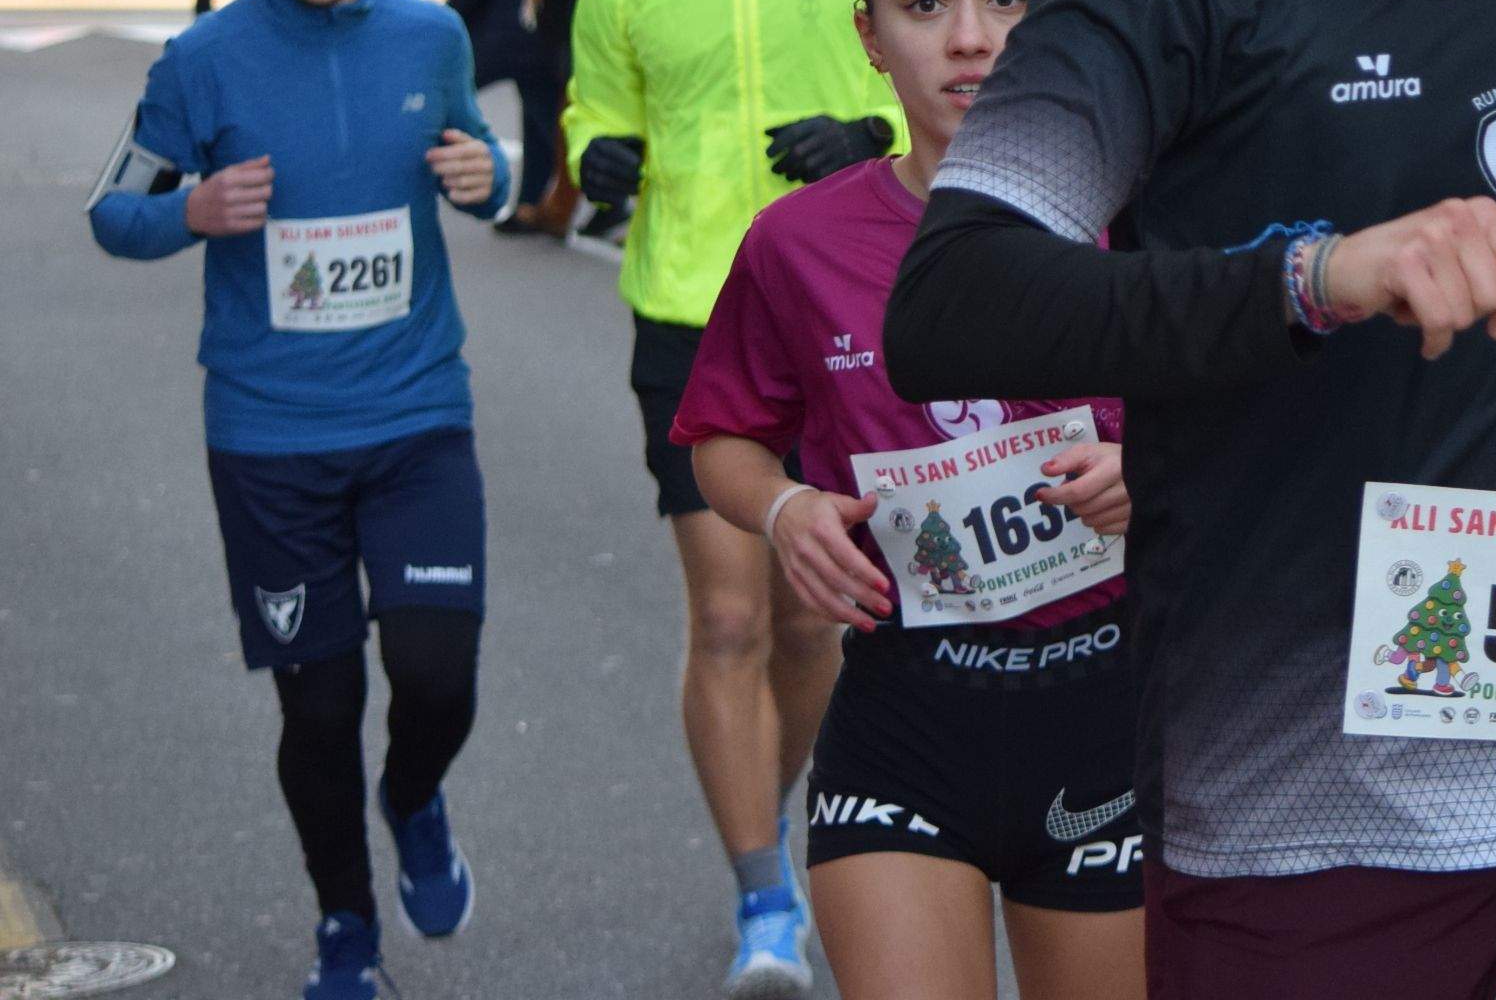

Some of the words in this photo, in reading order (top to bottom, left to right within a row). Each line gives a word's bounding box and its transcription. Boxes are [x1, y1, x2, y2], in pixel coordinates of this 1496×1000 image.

[1331, 76, 1422, 103] amura
[328, 250, 403, 293] 2261
[825, 351, 874, 371] mura
[914, 458, 960, 485] SAN
[964, 423, 1068, 472] SILVESTR
[978, 551, 1068, 593] PONTEVEDRA
[934, 638, 1036, 672] NIKE
[1038, 623, 1122, 669] PRO
